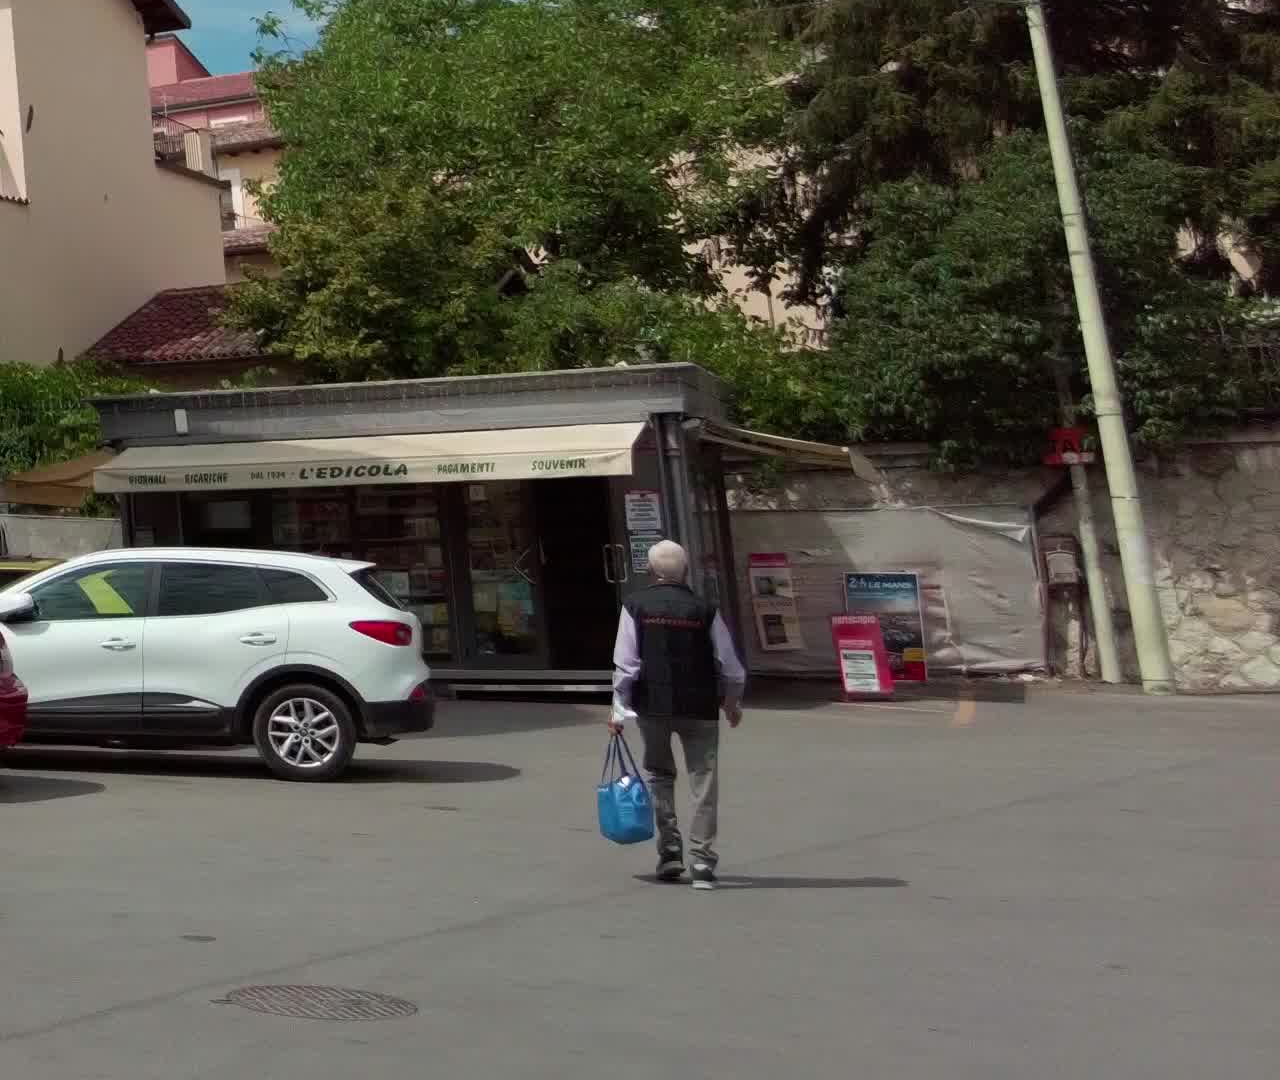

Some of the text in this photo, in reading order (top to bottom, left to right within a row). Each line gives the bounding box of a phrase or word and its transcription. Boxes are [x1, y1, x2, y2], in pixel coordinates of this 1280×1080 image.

[128, 473, 167, 485] GIORNALI
[184, 472, 228, 485] RICARICHE
[299, 463, 408, 480] L'EDICOLA
[436, 461, 495, 475] PAGAMENTI
[531, 457, 586, 471] SOUVENIR
